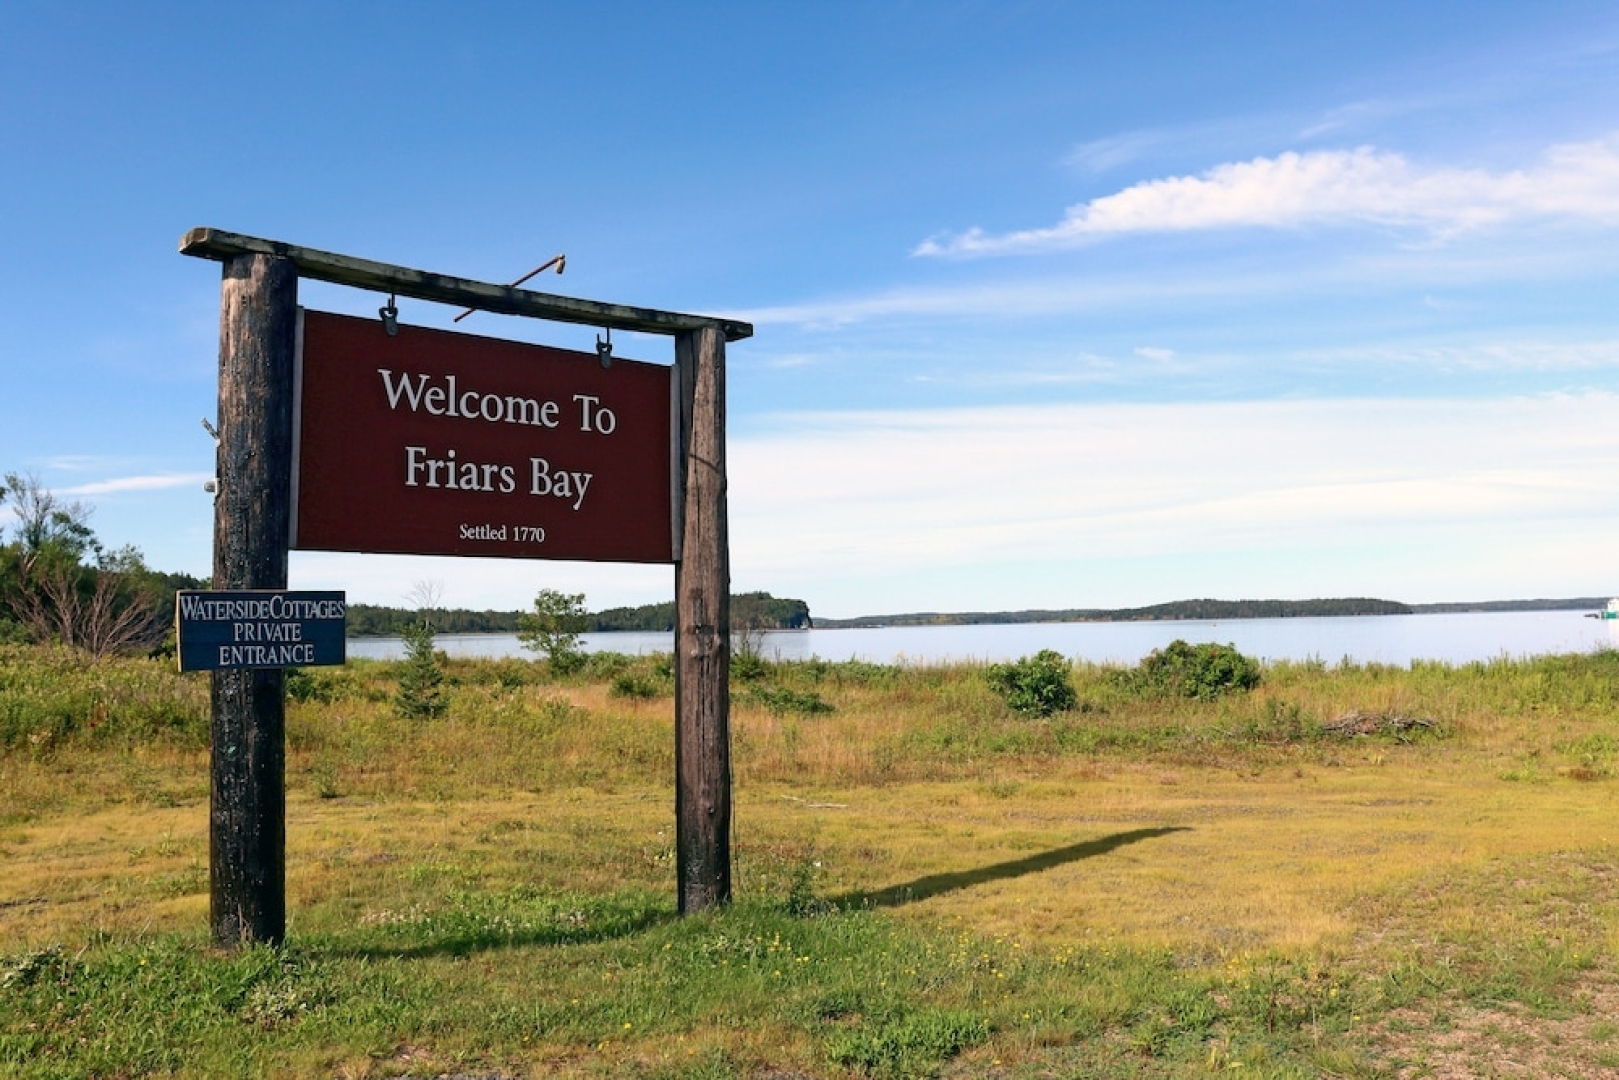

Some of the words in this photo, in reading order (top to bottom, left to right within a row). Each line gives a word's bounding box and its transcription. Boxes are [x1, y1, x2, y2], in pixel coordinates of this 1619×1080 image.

[377, 368, 560, 428] Welcome
[572, 394, 617, 435] To
[405, 446, 516, 493] Friars
[530, 457, 593, 511] Bay
[459, 523, 507, 541] Settled
[513, 526, 546, 543] 1770
[233, 622, 302, 642] PRIVATE
[219, 644, 315, 666] ENTRANCE
